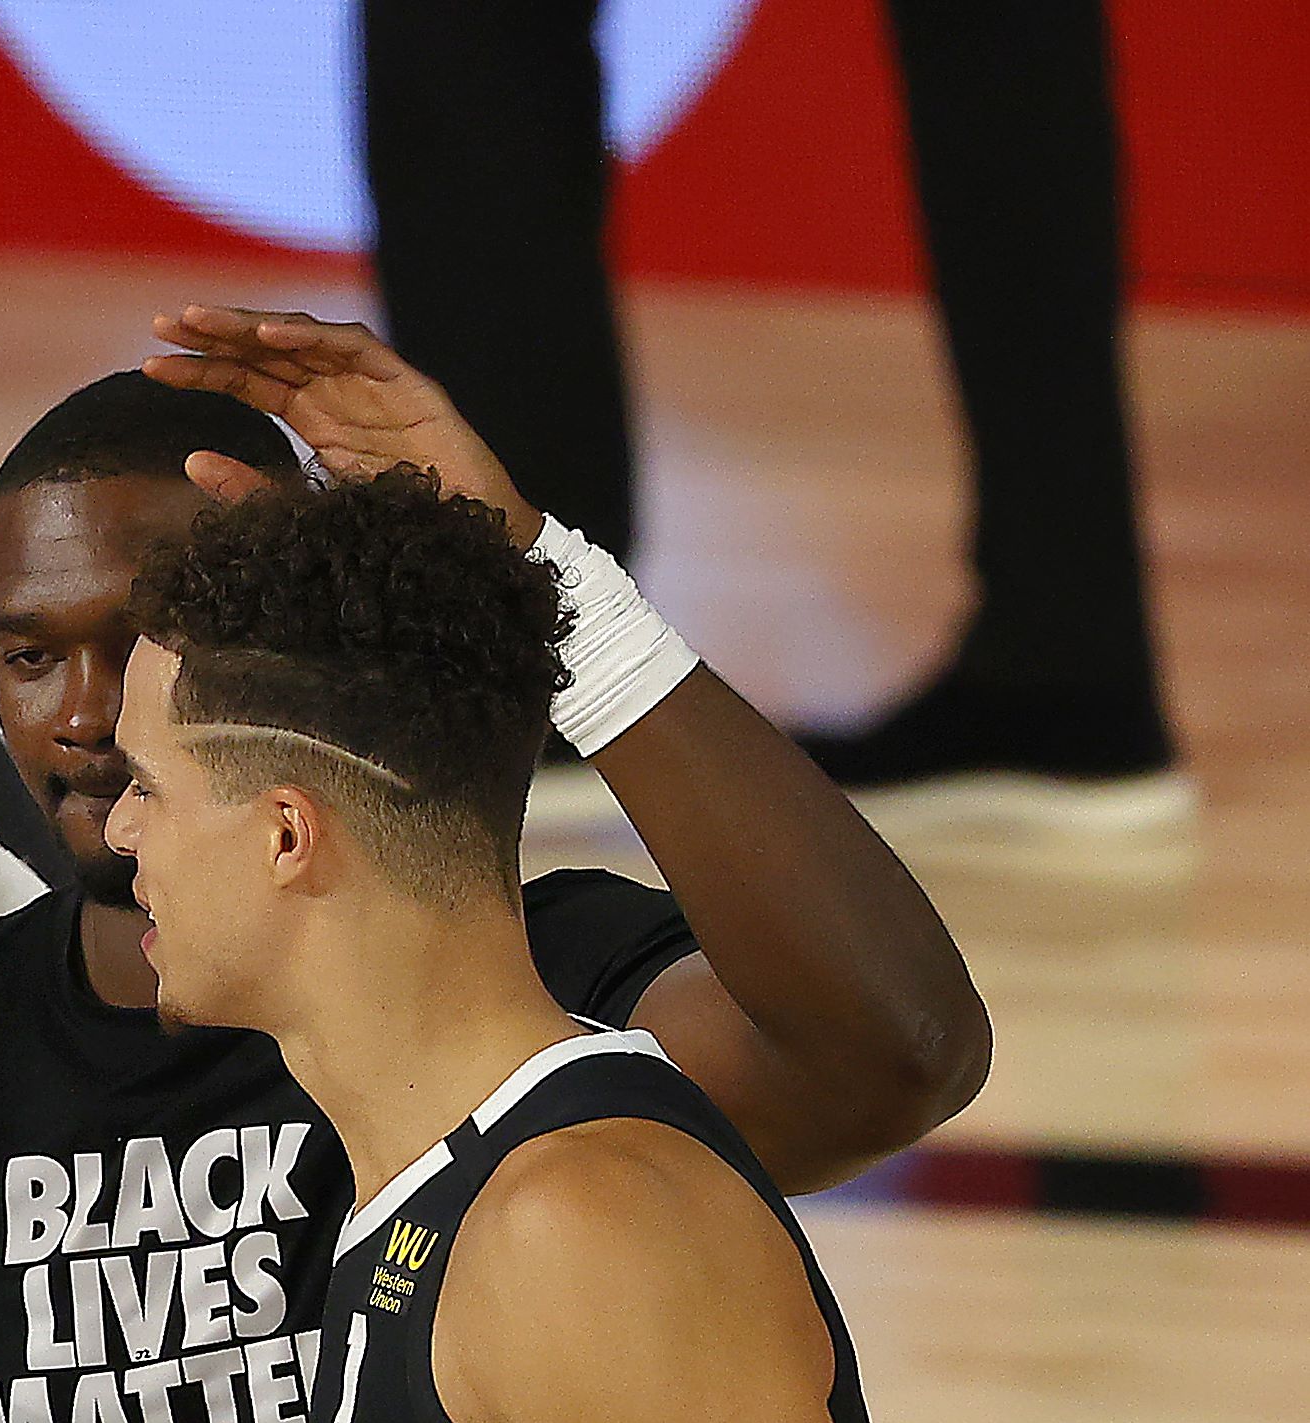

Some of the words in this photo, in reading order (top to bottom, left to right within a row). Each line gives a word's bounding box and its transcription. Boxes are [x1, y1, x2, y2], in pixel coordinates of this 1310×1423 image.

[4, 1122, 312, 1265] BLACK
[385, 1218, 439, 1271] WU
[23, 1231, 287, 1370] LIVES
[369, 1286, 401, 1314] Union
[372, 1265, 415, 1296] Western
